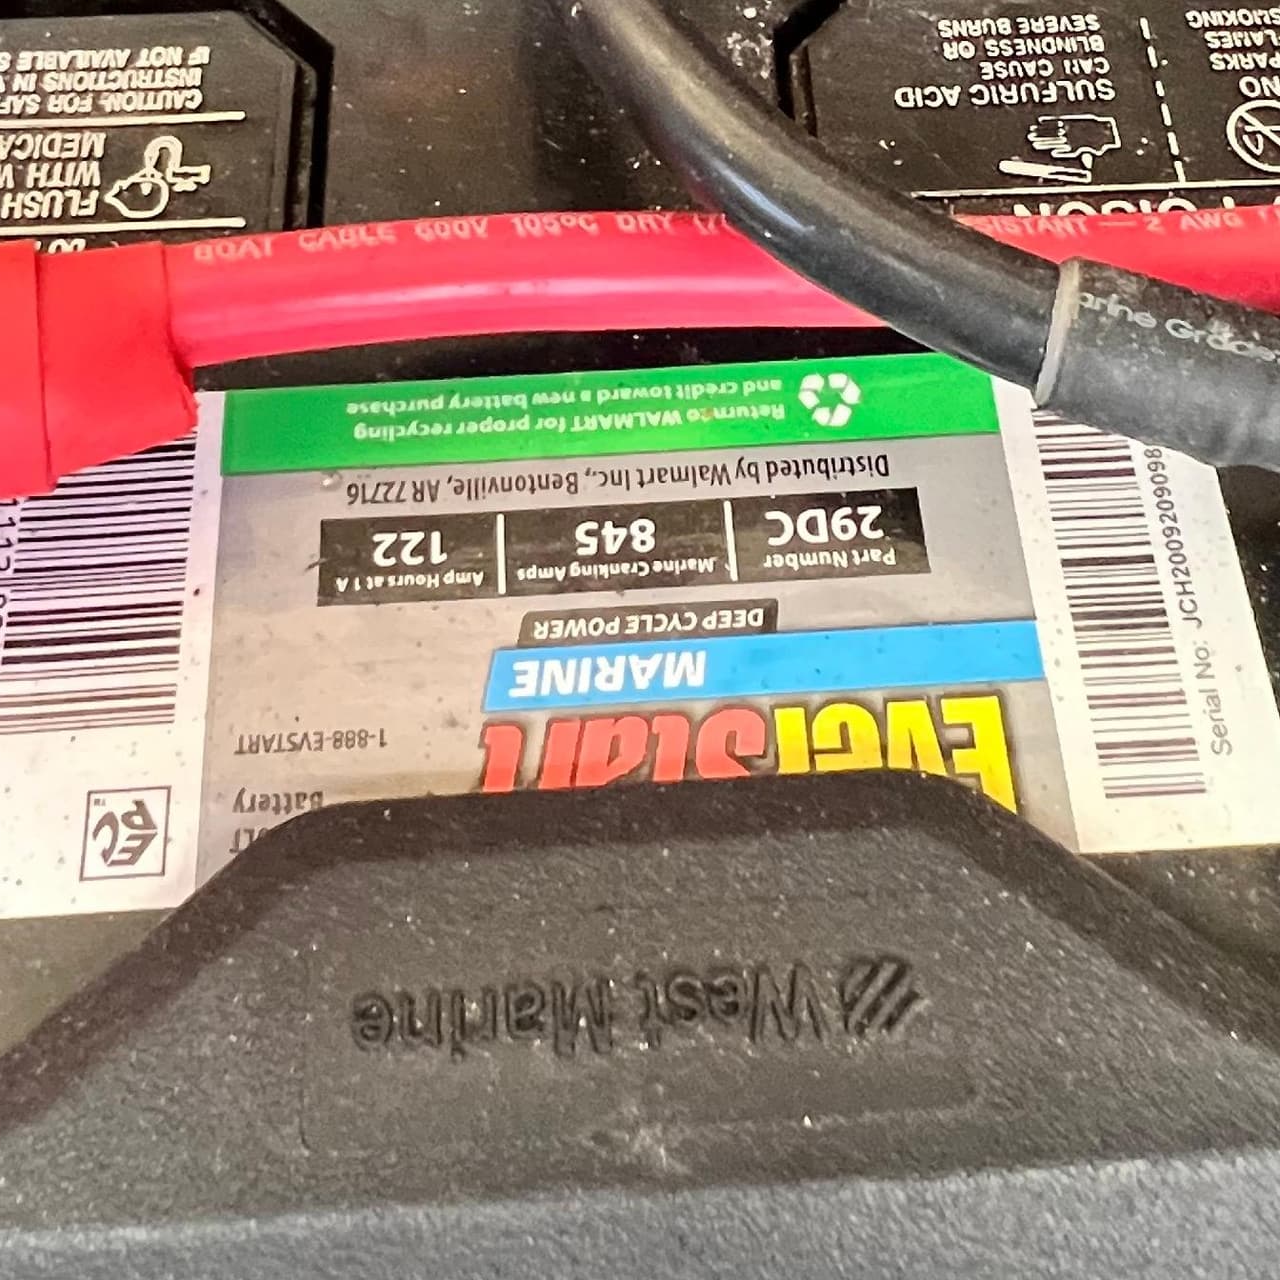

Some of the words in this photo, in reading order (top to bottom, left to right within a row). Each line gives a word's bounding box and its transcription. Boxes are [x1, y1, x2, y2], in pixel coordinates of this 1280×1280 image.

[936, 18, 1012, 39] BURNS
[1015, 13, 1100, 34] SEVERE
[136, 47, 183, 67] NOT
[188, 45, 210, 65] IF
[942, 40, 976, 61] OR
[985, 35, 1105, 57] BLINDNESS
[17, 48, 131, 71] AVAILABLE
[979, 58, 1054, 80] CAUSE
[1063, 57, 1110, 75] CAN
[12, 73, 36, 93] IN
[41, 68, 203, 92] INSTRUCTIONS
[894, 85, 962, 108] ACID
[968, 78, 1116, 106] SULFURIC
[48, 93, 93, 114] FOR
[27, 162, 101, 187] WITH
[0, 190, 100, 219] FLUSH
[1180, 211, 1243, 231] AWG
[193, 240, 274, 262] BOAT
[299, 225, 397, 250] CABLE
[1078, 292, 1158, 328] arine
[580, 390, 592, 403] a
[596, 384, 672, 405] toward
[675, 381, 738, 401] credit
[742, 378, 782, 396] and
[345, 395, 444, 416] purchase
[448, 392, 527, 412] battery
[531, 391, 576, 406] new
[570, 410, 683, 432] WALMART
[713, 403, 785, 420] Return
[352, 421, 452, 443] recycling
[455, 415, 530, 436] proper
[535, 417, 566, 433] for
[584, 467, 630, 492] Inc.,
[636, 464, 731, 489] Walmart
[735, 456, 760, 484] by
[766, 455, 889, 484] Distributed
[346, 480, 407, 506] 72716
[411, 479, 440, 504] AR
[446, 472, 579, 501] Bentonville,
[764, 504, 884, 546] 29DC
[575, 518, 656, 556] 845
[371, 530, 448, 567] 122
[850, 547, 897, 566] Part
[570, 558, 649, 580] Cranking
[653, 558, 714, 574] Marine
[762, 550, 849, 571] Number
[353, 577, 361, 591] 1
[366, 575, 385, 590] at
[387, 572, 440, 589] Hours
[443, 569, 484, 587] Amp
[517, 564, 566, 582] Amps
[336, 577, 349, 592] A
[533, 613, 621, 640] POWER
[625, 610, 697, 635] CYCLE
[702, 607, 764, 632] DEEP
[1193, 639, 1218, 680] No:
[507, 649, 707, 696] MARINE
[1200, 687, 1233, 756] Serial
[233, 728, 388, 756] 1-888-EVSTART
[232, 787, 324, 816] Battery
[634, 962, 826, 1050] West
[350, 977, 612, 1064] Marine
